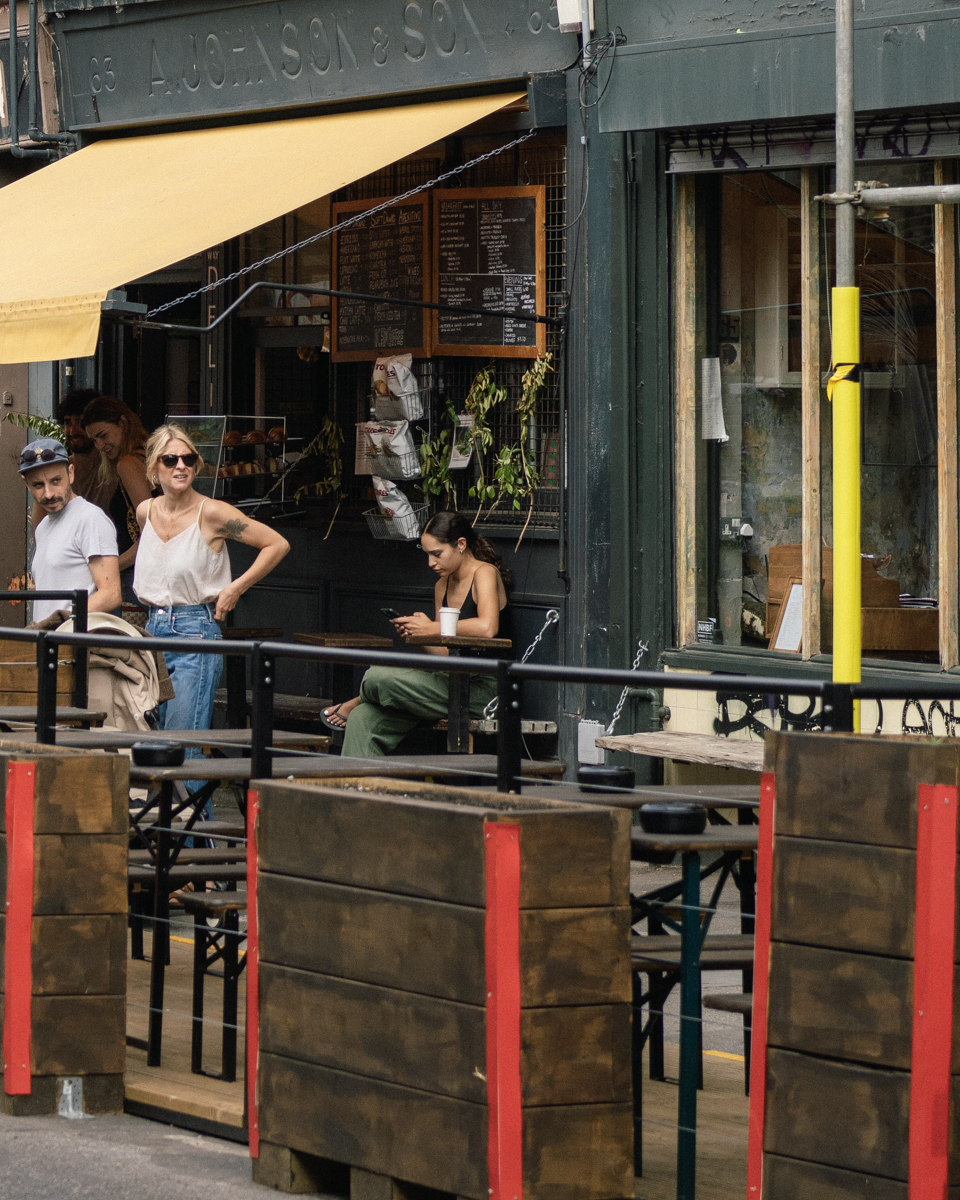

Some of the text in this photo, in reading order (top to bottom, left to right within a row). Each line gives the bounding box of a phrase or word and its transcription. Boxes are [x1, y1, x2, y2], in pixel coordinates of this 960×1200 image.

[90, 56, 117, 93] 63
[370, 26, 389, 68] &
[208, 266, 218, 407] DELI
[375, 364, 397, 377] TOES
